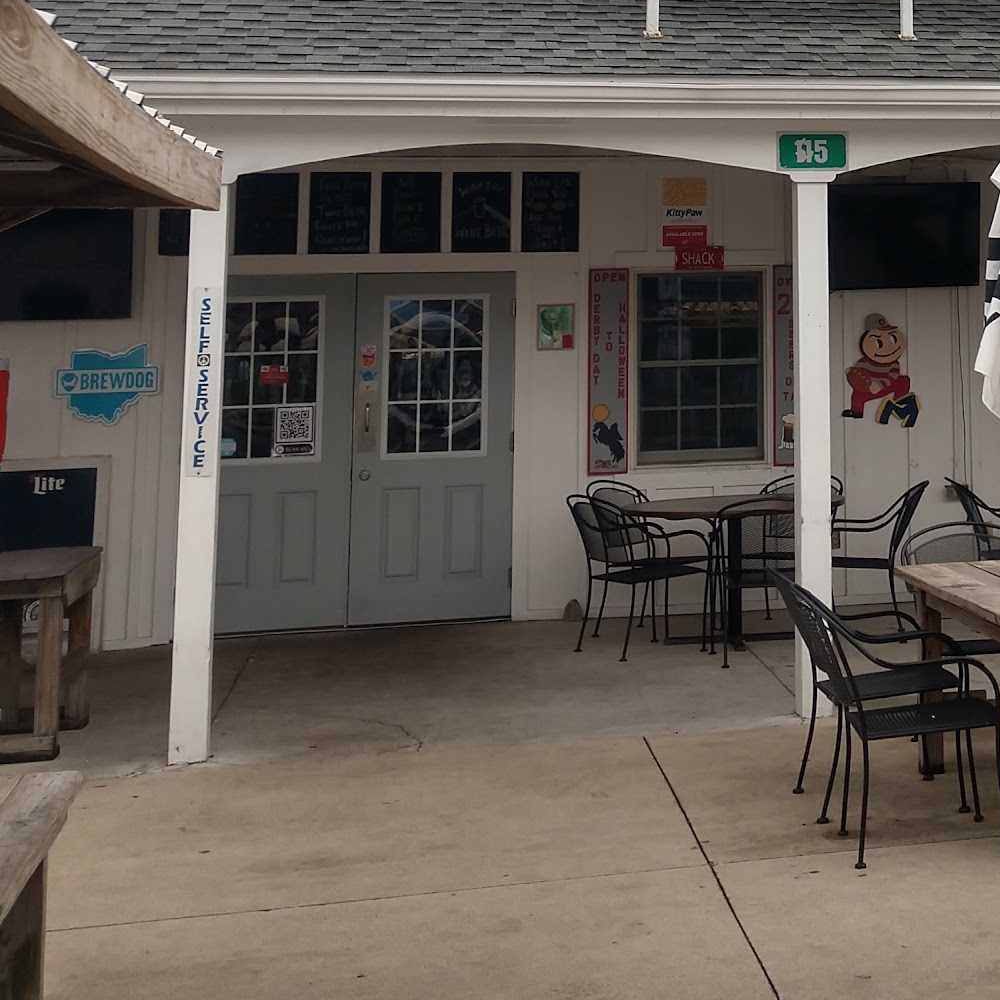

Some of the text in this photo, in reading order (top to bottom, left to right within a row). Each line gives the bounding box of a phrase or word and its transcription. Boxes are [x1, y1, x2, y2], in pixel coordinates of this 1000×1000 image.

[666, 208, 703, 219] KittyPaw
[682, 252, 715, 265] SHACK
[594, 273, 626, 283] OPEN
[777, 293, 791, 315] 2
[592, 294, 602, 385] DERBY DAY
[605, 331, 613, 352] TO
[617, 304, 627, 399] HALLOWEEN
[80, 371, 154, 391] BREWDOG
[193, 298, 212, 468] SELF SERVICE
[32, 476, 65, 495] Lite
